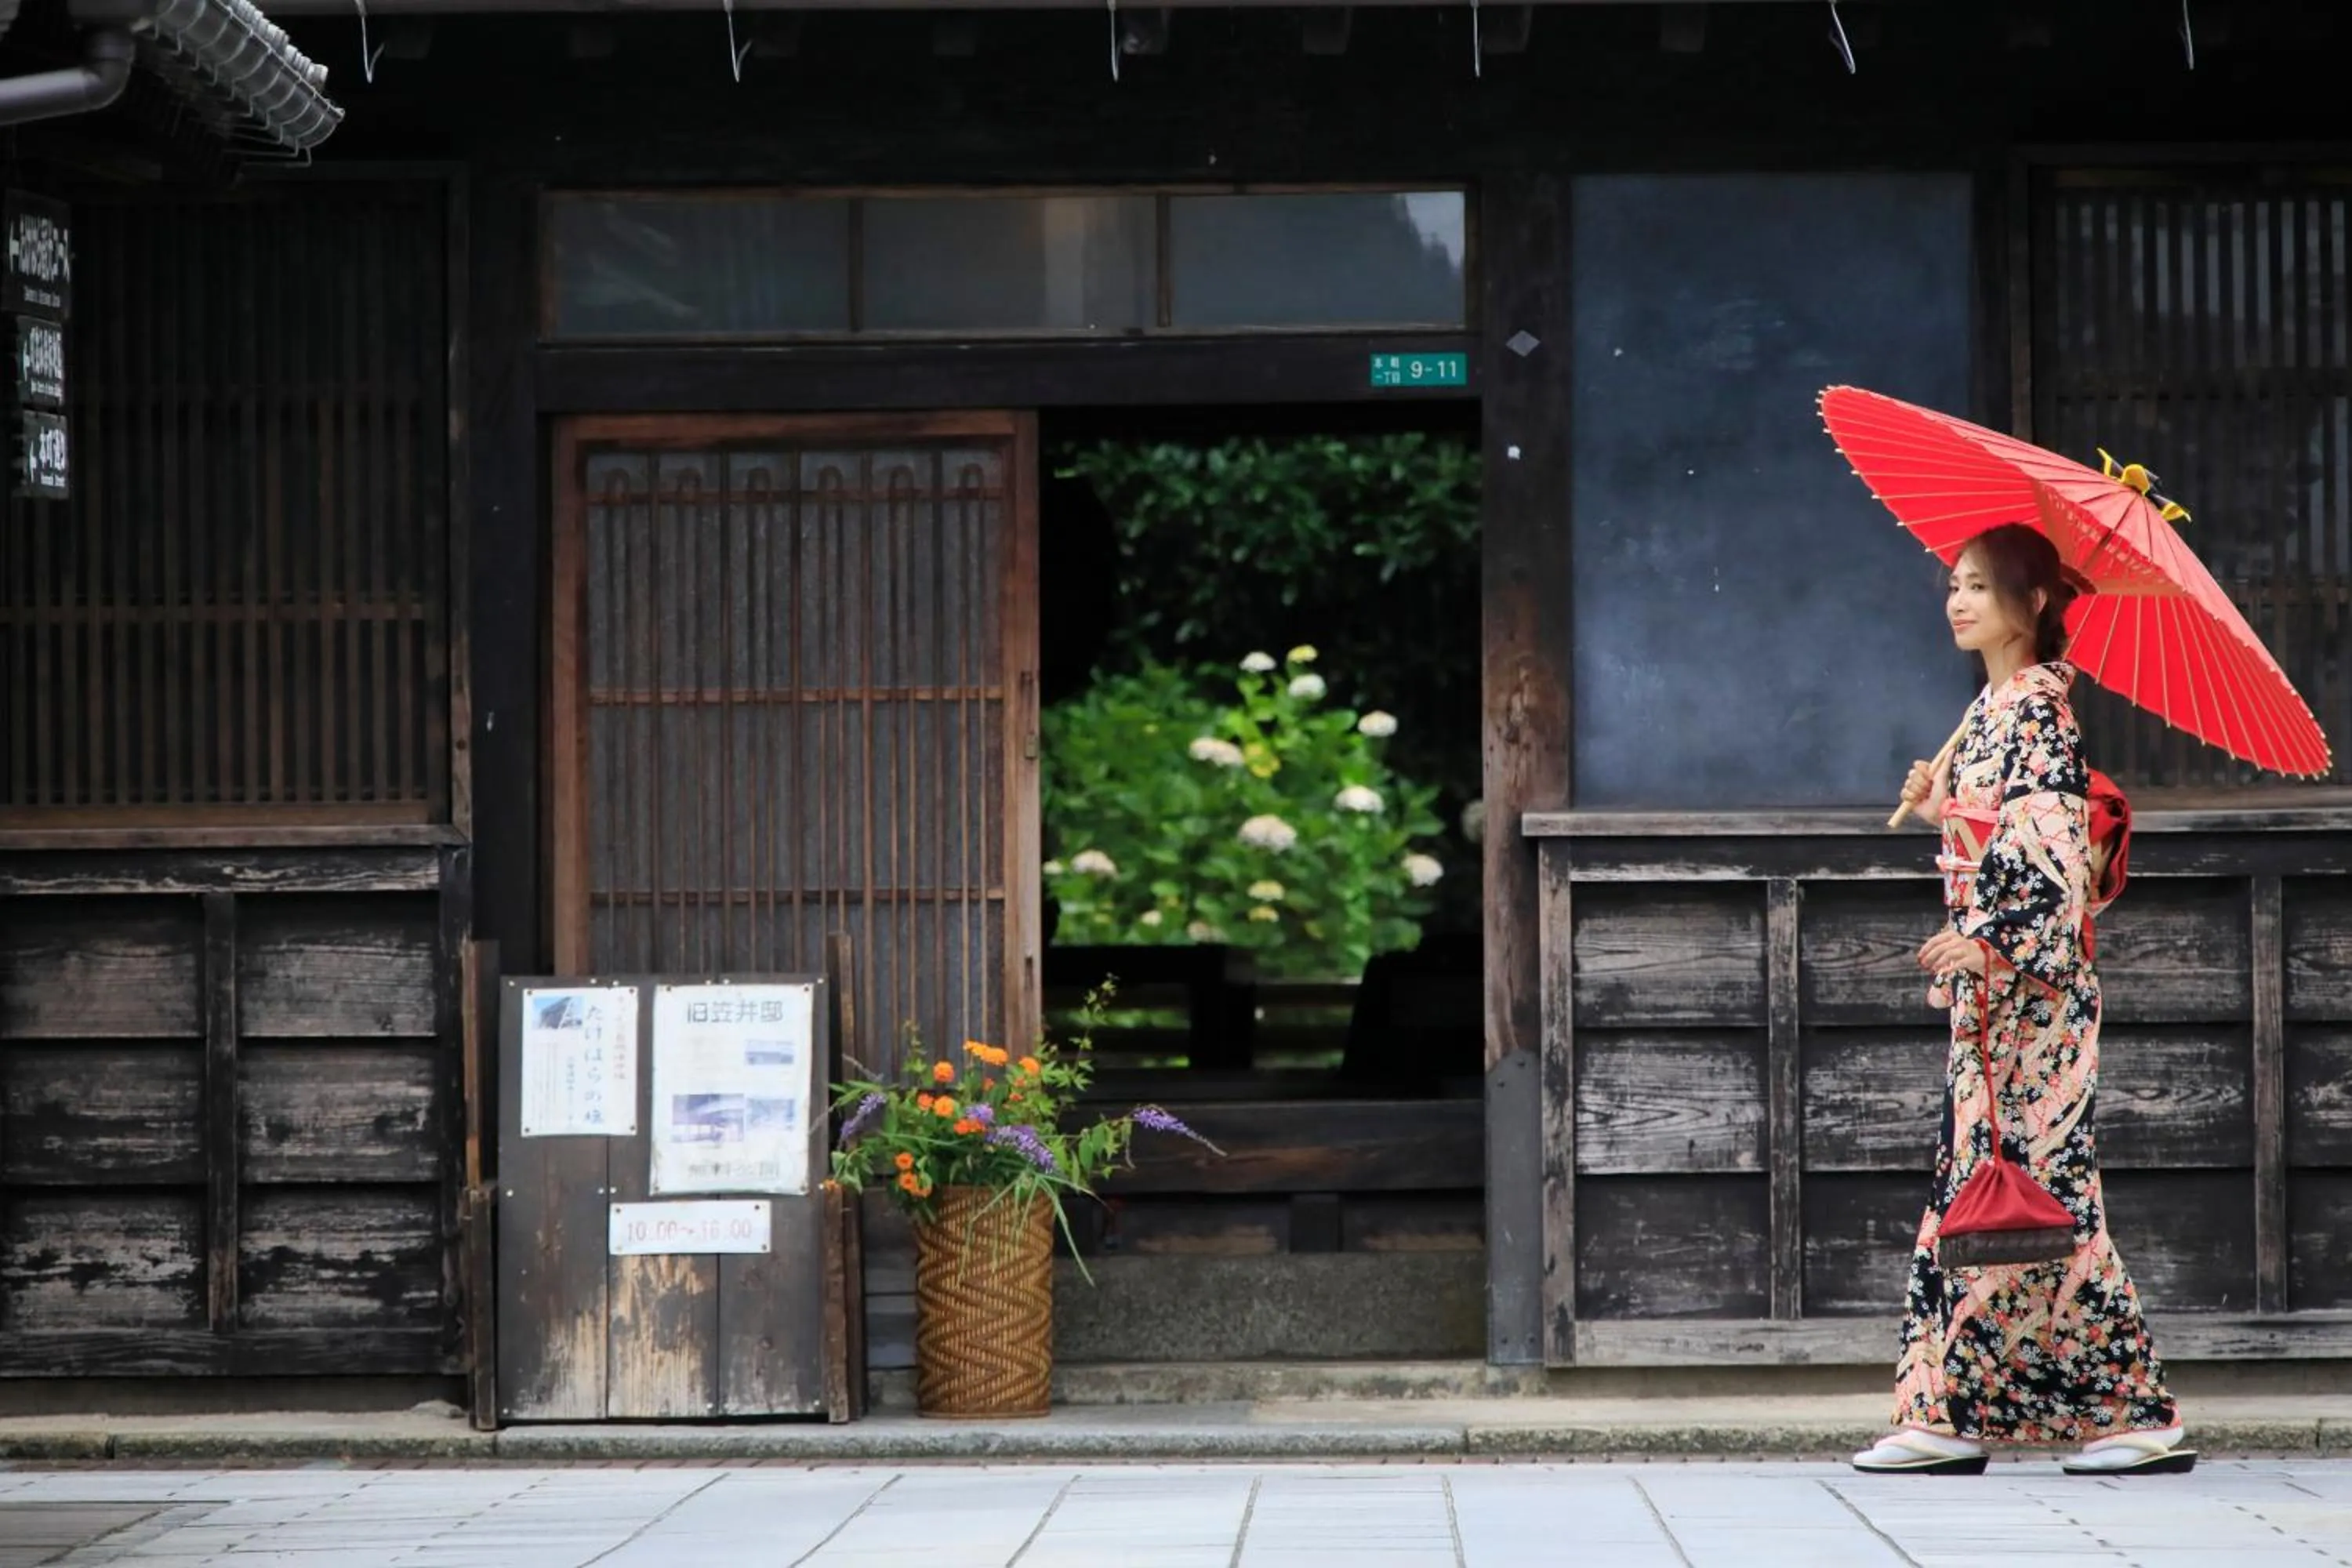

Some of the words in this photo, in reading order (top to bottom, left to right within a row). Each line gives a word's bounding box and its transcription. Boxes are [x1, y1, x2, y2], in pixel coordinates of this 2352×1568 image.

[1410, 361, 1457, 378] 9-11
[688, 1000, 783, 1023] 旧笠井邸
